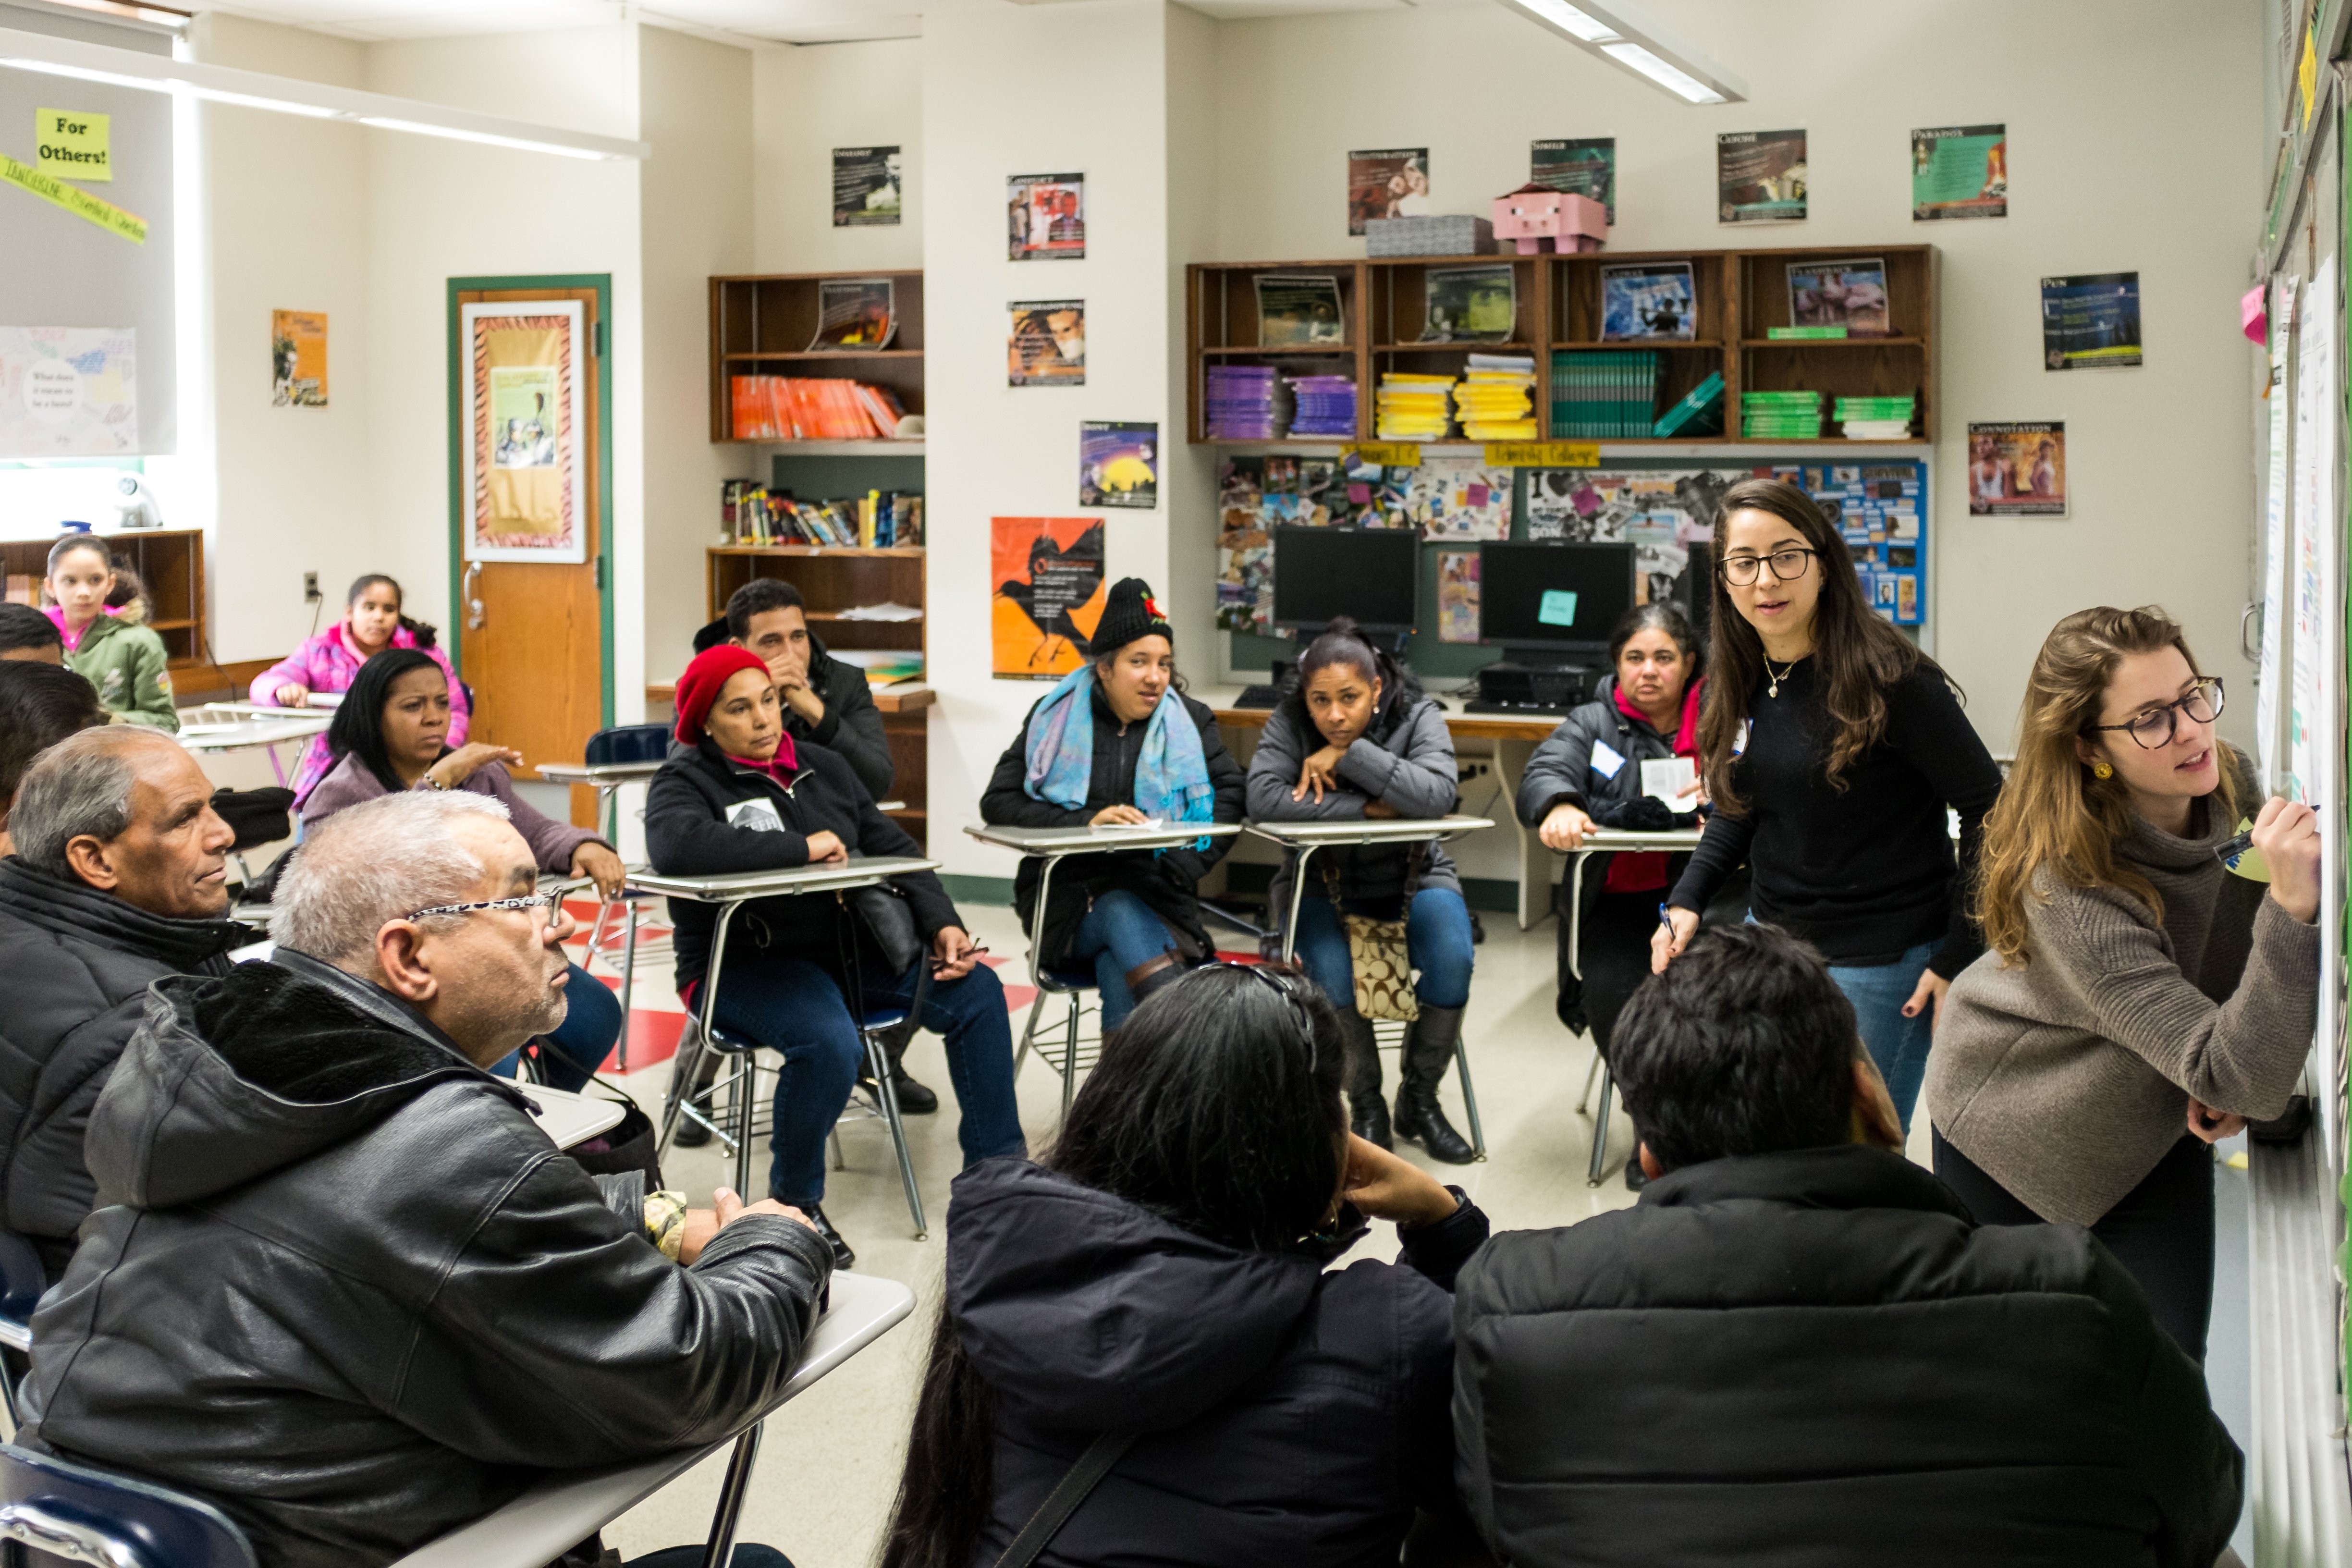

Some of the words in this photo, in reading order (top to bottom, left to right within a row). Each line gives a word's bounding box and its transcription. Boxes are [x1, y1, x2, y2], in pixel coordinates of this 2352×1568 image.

[56, 117, 87, 135] For
[1912, 129, 1963, 140] PARADOX
[39, 145, 106, 164] Others!
[2043, 277, 2067, 288] PUN
[1969, 425, 2052, 434] CONNOTATION
